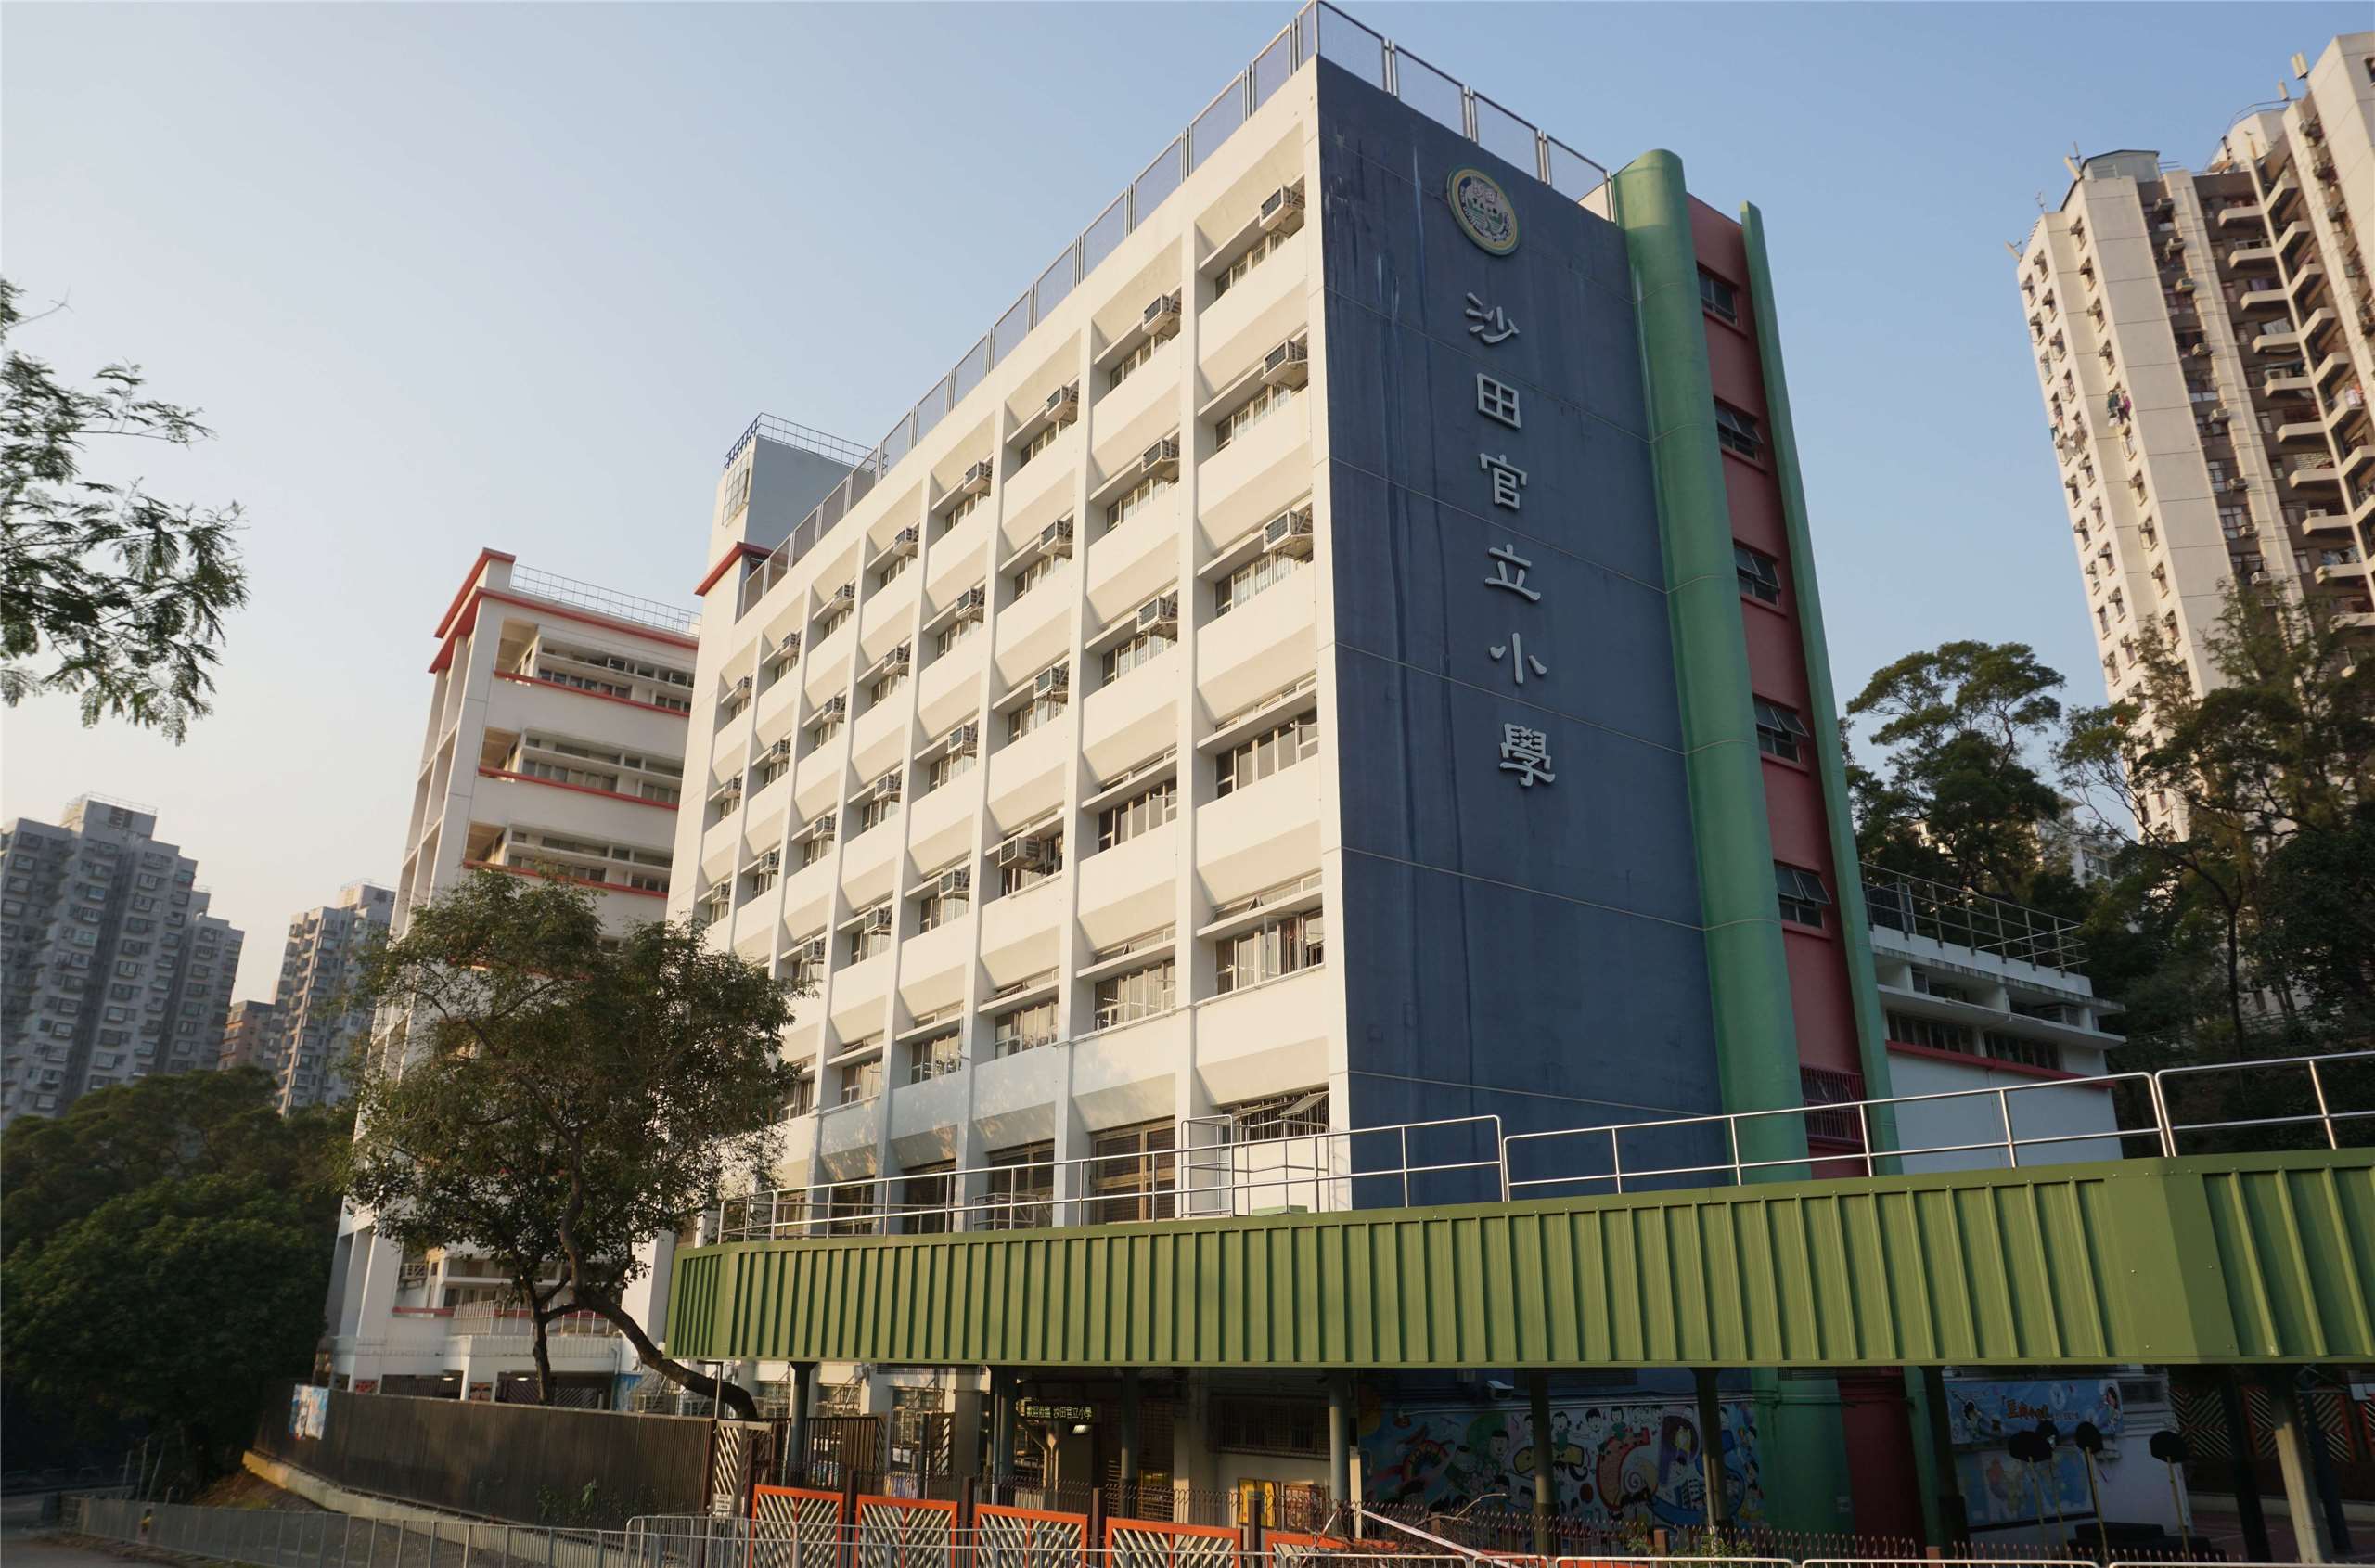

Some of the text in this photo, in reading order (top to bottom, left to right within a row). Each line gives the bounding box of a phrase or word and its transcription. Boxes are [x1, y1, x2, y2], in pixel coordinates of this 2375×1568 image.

[1465, 291, 1556, 787] 沙田官立小學
[1053, 1406, 1092, 1420] 沙田官立小學
